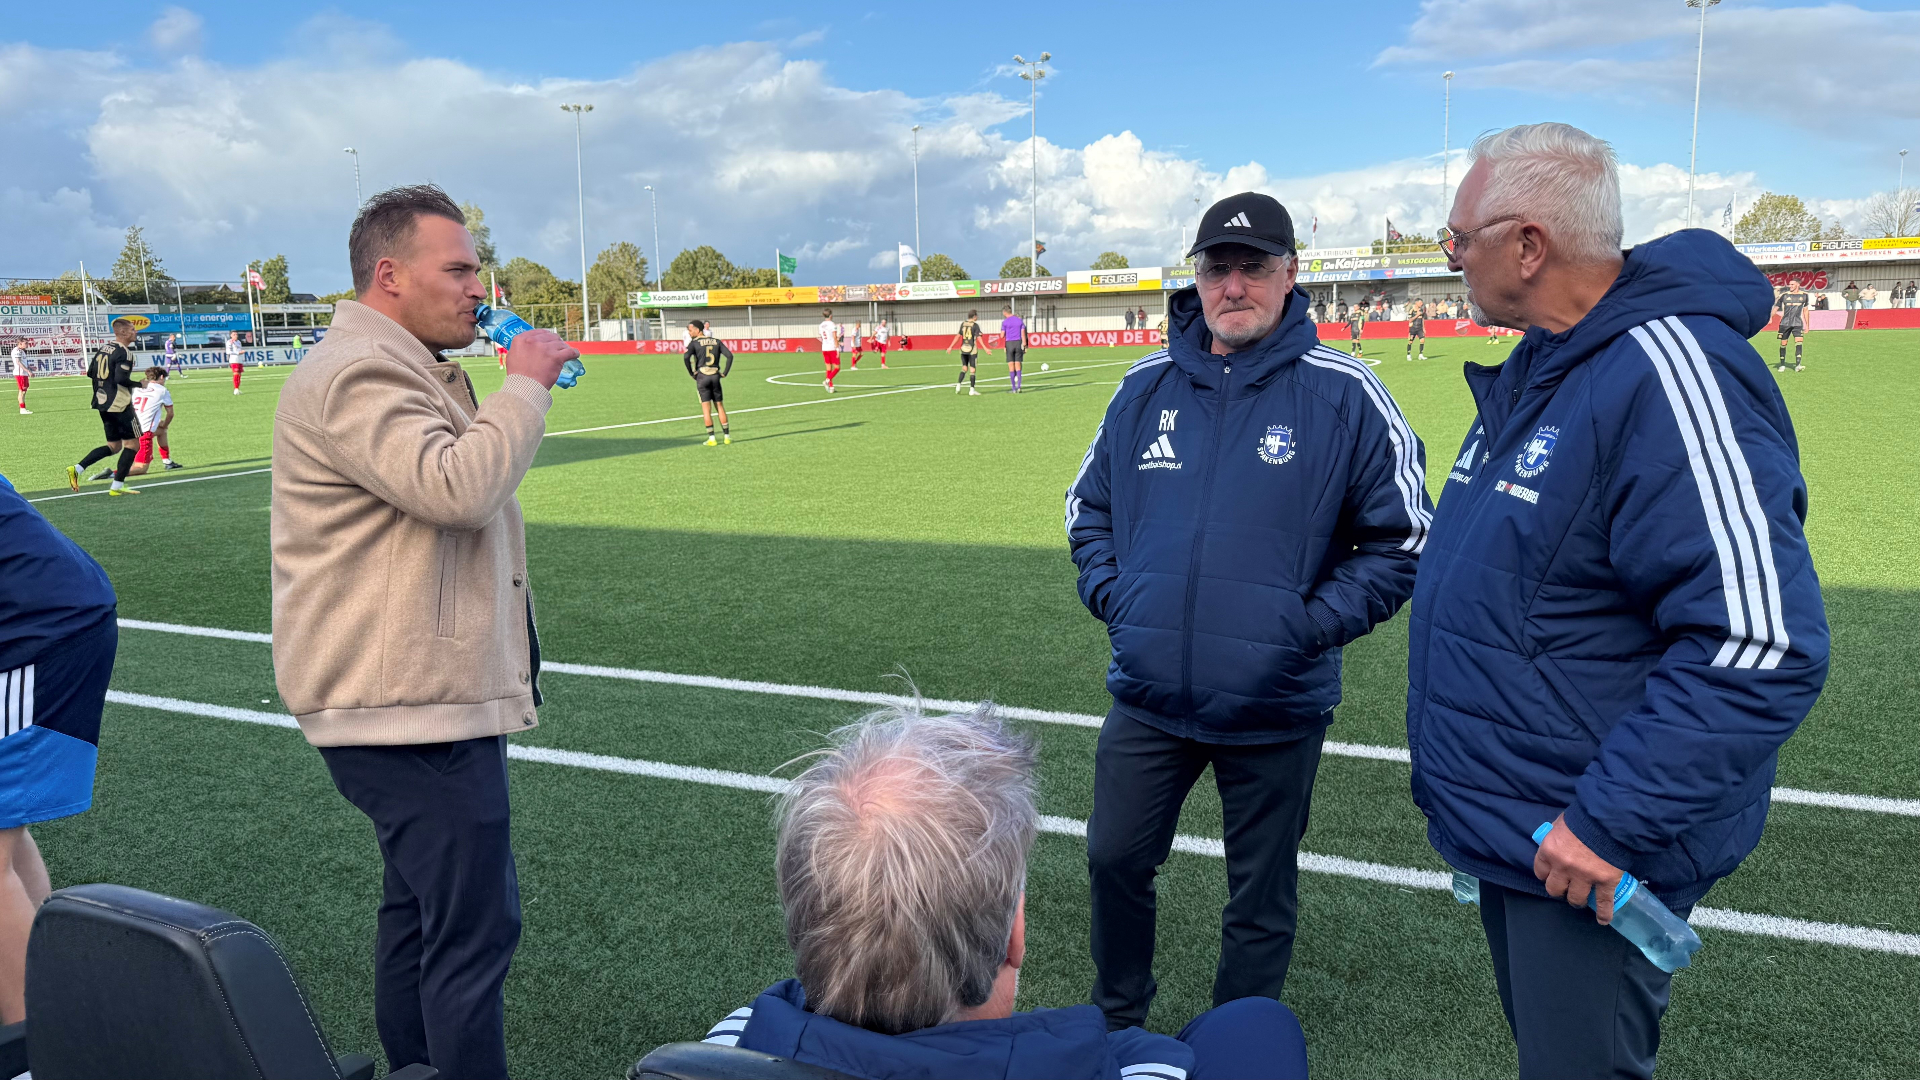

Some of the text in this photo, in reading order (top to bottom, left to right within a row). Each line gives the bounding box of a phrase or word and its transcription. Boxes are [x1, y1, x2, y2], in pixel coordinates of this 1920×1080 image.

[1747, 245, 1793, 254] Werkendam
[1310, 260, 1322, 272] &
[1312, 271, 1353, 282] Heuvel
[1014, 280, 1063, 292] SYSTEMS
[653, 294, 689, 303] Koopmans
[690, 292, 706, 301] Verf
[31, 305, 69, 315] UNITS
[153, 313, 172, 323] Daar
[199, 312, 234, 323] energie
[1086, 332, 1118, 345] VAN
[1123, 332, 1144, 344] DE
[742, 341, 759, 351] DE
[762, 340, 787, 351] DAG
[152, 350, 275, 367] WRKENDMSE
[705, 345, 716, 366] 5
[96, 354, 110, 380] 10
[133, 396, 149, 413] 21
[1159, 410, 1178, 431] RK
[1257, 446, 1296, 465] SPAKENBURG
[1514, 453, 1550, 478] SPAKENBURG
